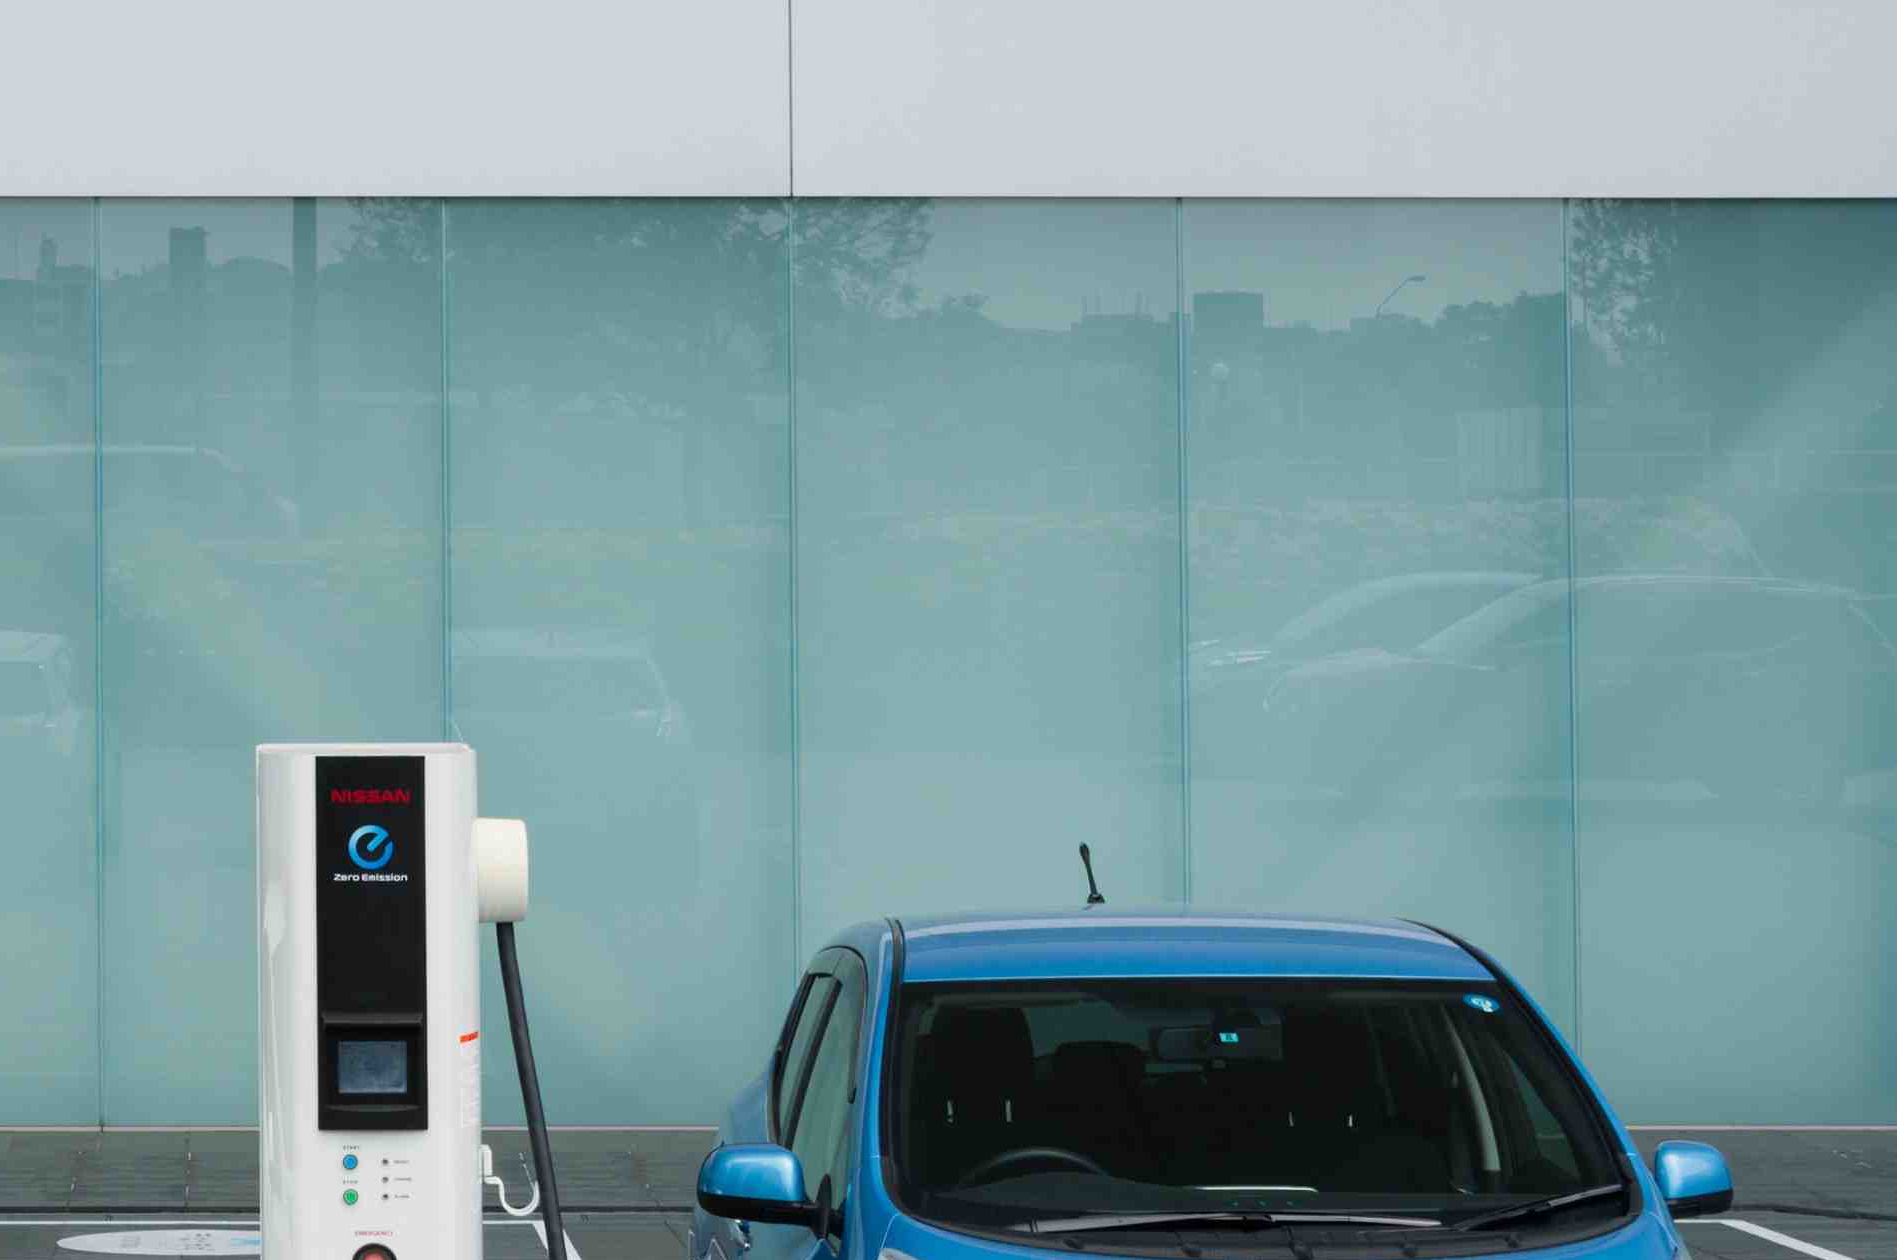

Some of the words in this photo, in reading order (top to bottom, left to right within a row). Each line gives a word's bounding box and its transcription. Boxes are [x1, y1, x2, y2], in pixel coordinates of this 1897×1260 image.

[330, 788, 411, 804] NISSAN
[333, 873, 360, 882] Zero
[361, 871, 408, 882] Emission
